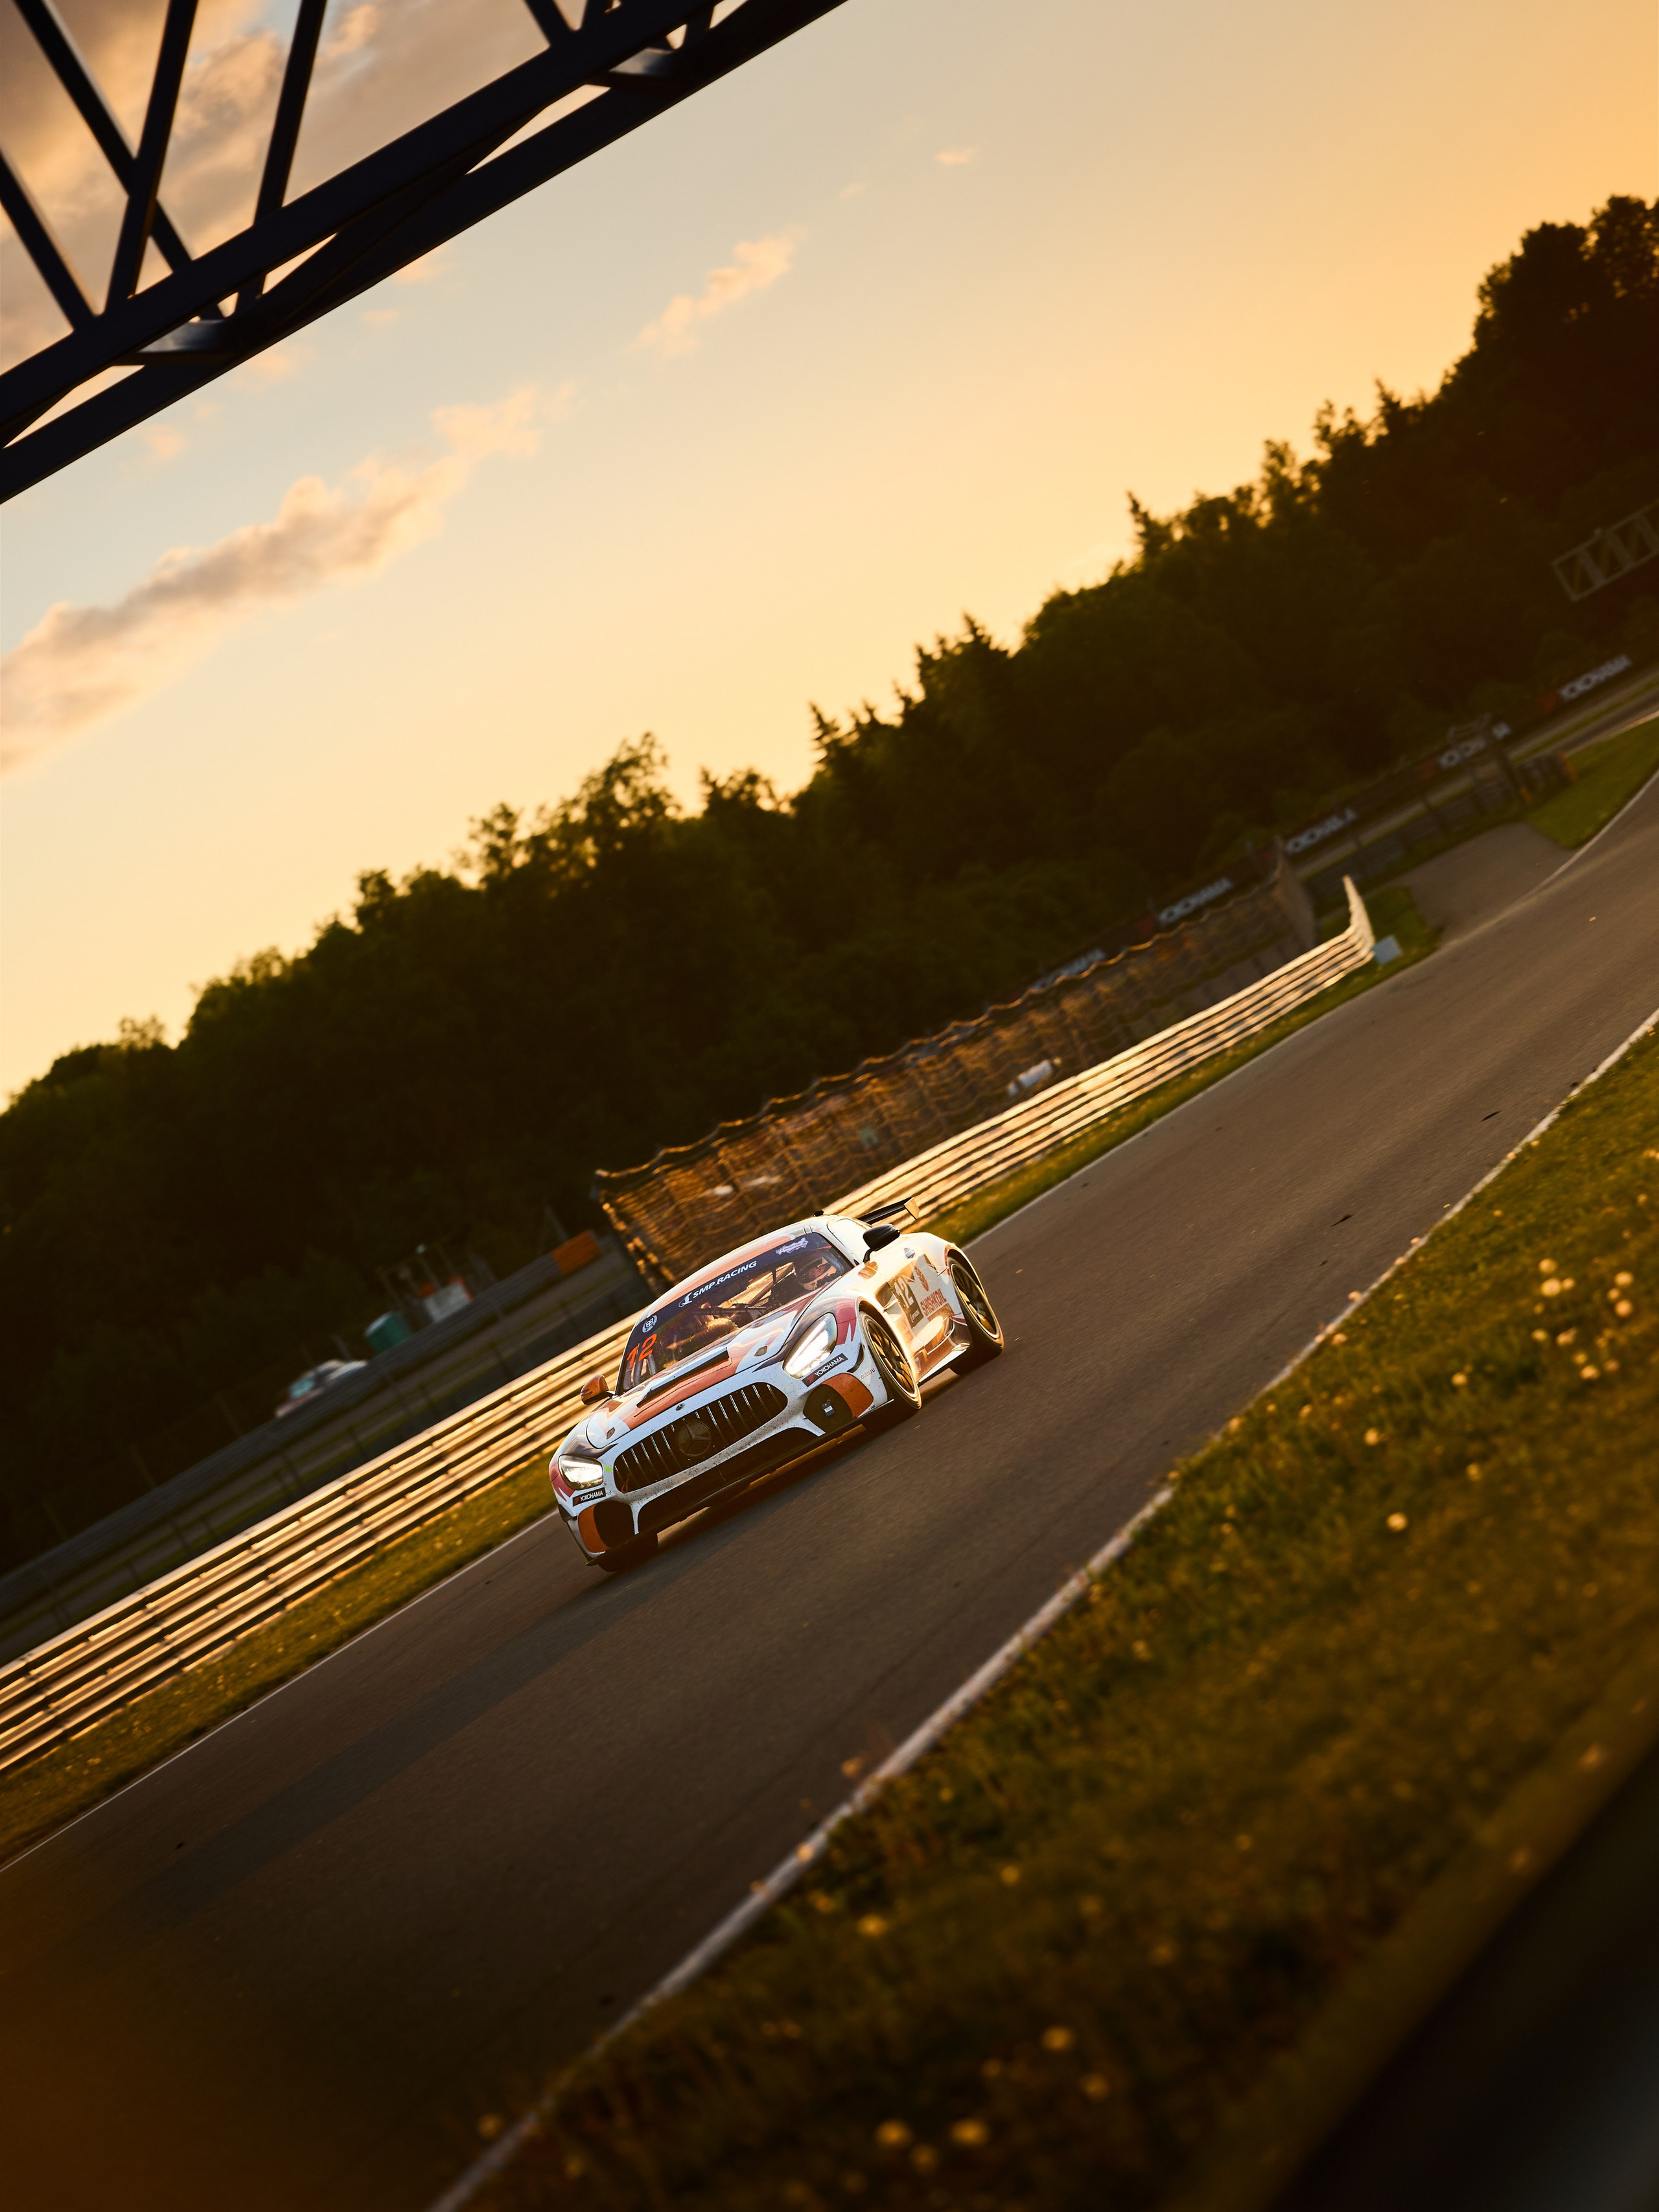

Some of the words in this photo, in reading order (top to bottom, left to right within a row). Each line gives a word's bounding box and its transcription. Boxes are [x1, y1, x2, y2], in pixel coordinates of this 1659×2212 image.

[693, 1281, 715, 1298] SMP
[715, 1261, 757, 1286] RACING
[627, 1333, 657, 1369] 12
[815, 1356, 844, 1377] YOKOHAMA
[580, 1490, 603, 1502] YOKOHAMA
